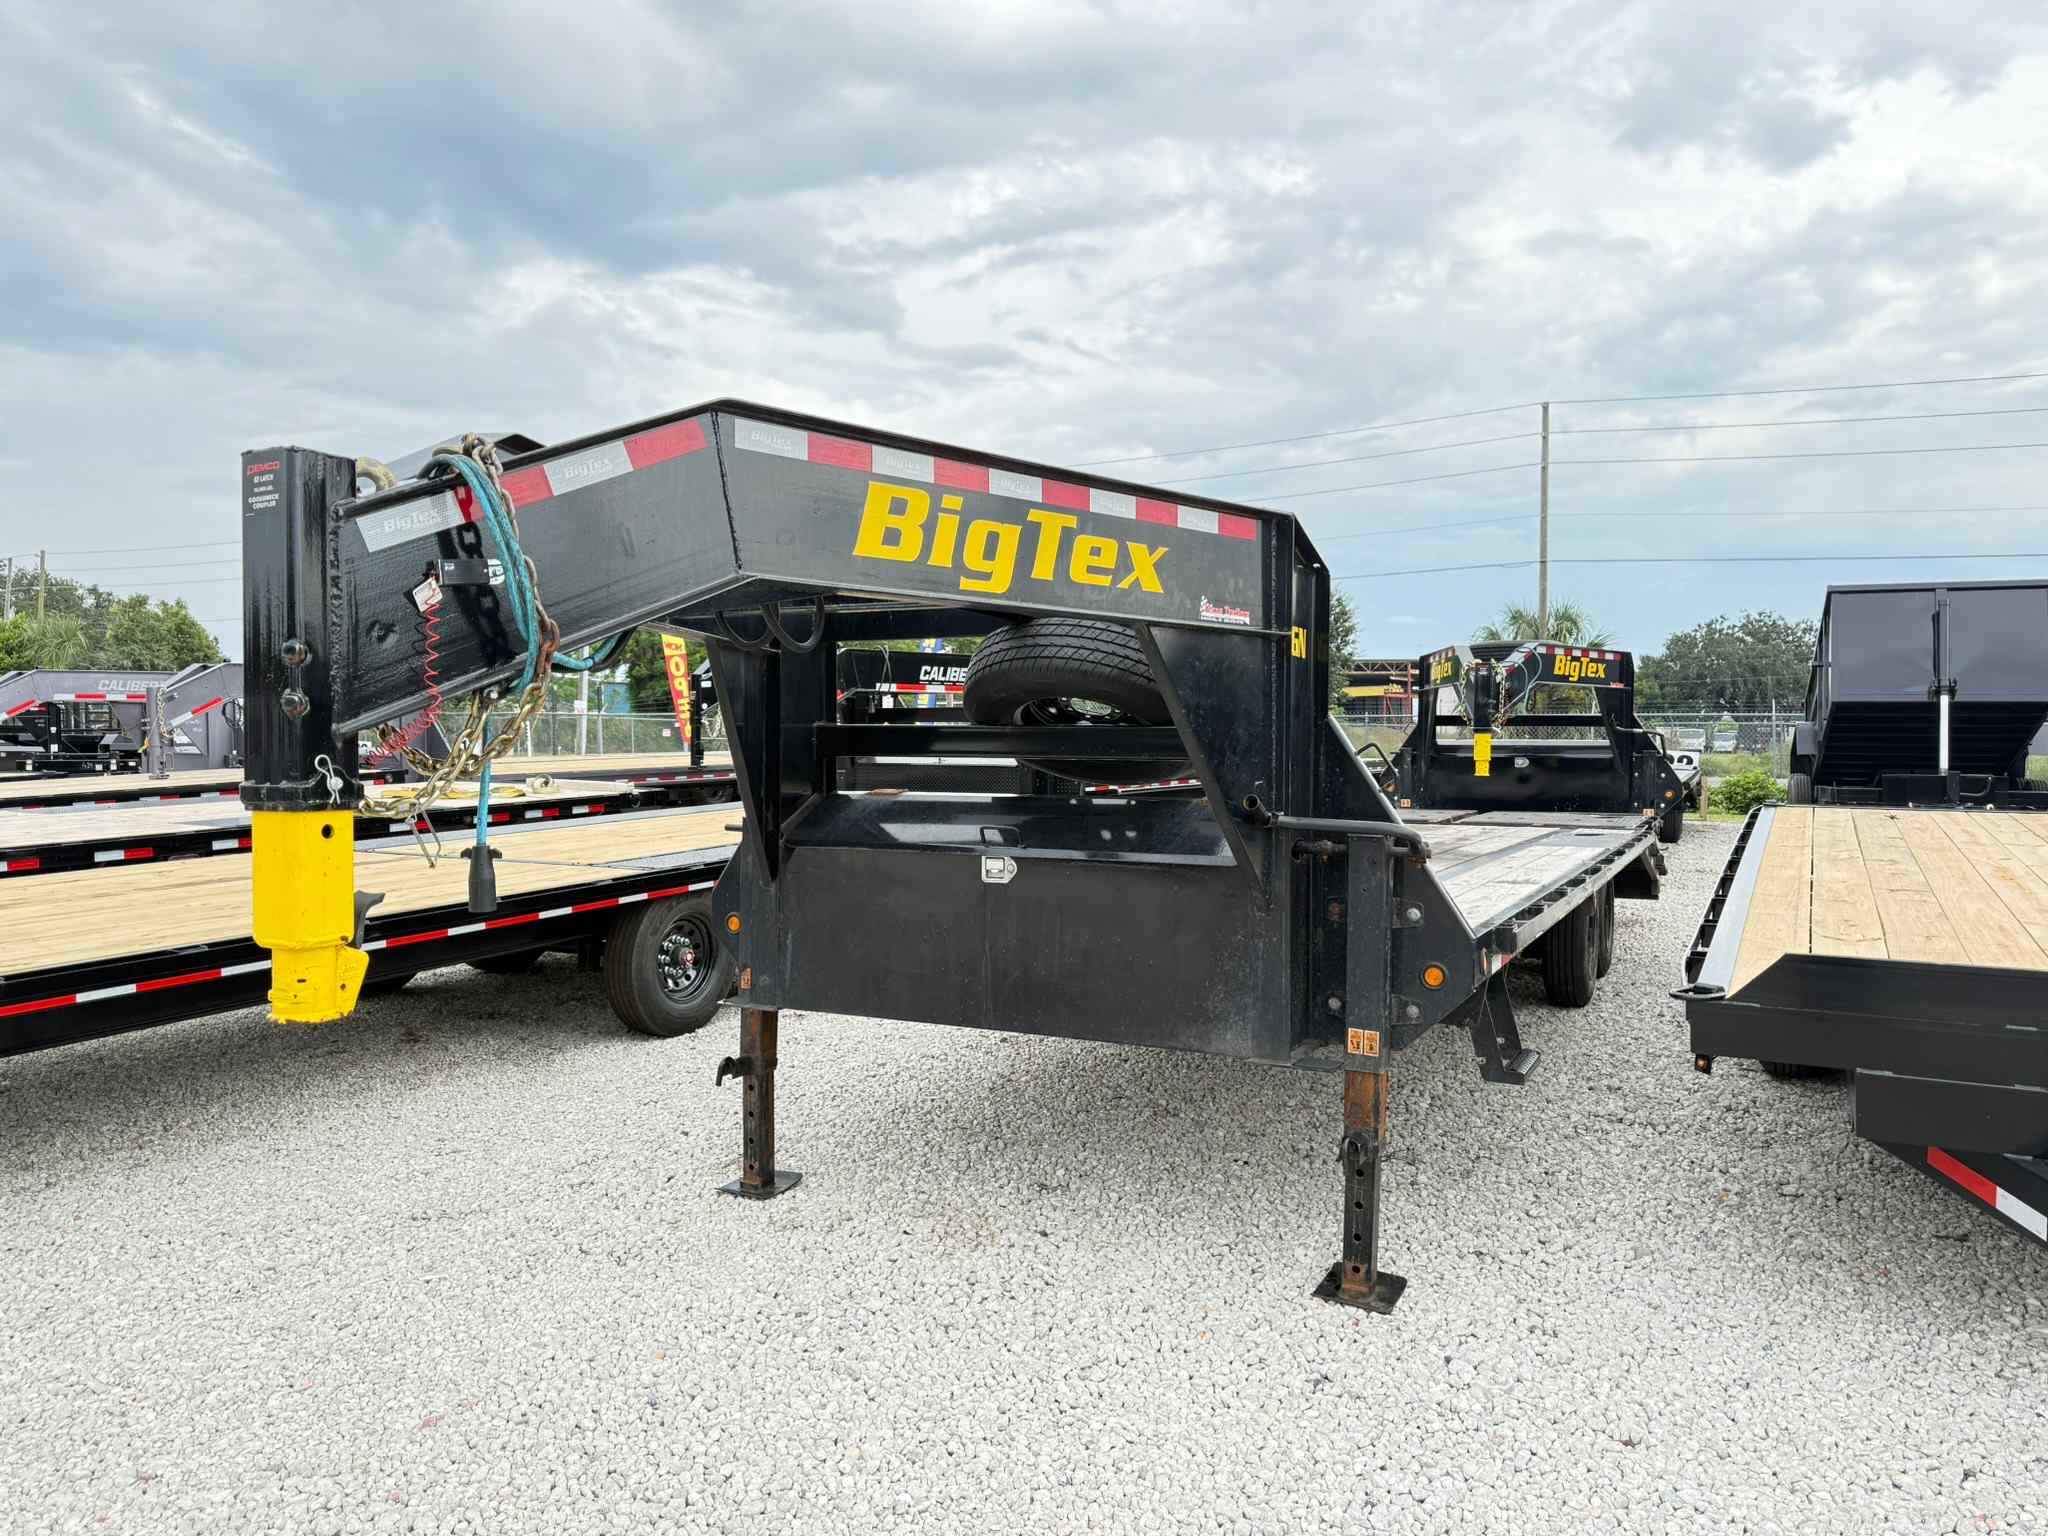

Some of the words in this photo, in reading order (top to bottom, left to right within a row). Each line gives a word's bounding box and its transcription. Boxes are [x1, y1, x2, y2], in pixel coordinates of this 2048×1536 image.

[564, 457, 612, 478] BigTex
[383, 508, 441, 532] BigTex
[852, 480, 1169, 594] BigTex
[1553, 655, 1607, 682] BigTex
